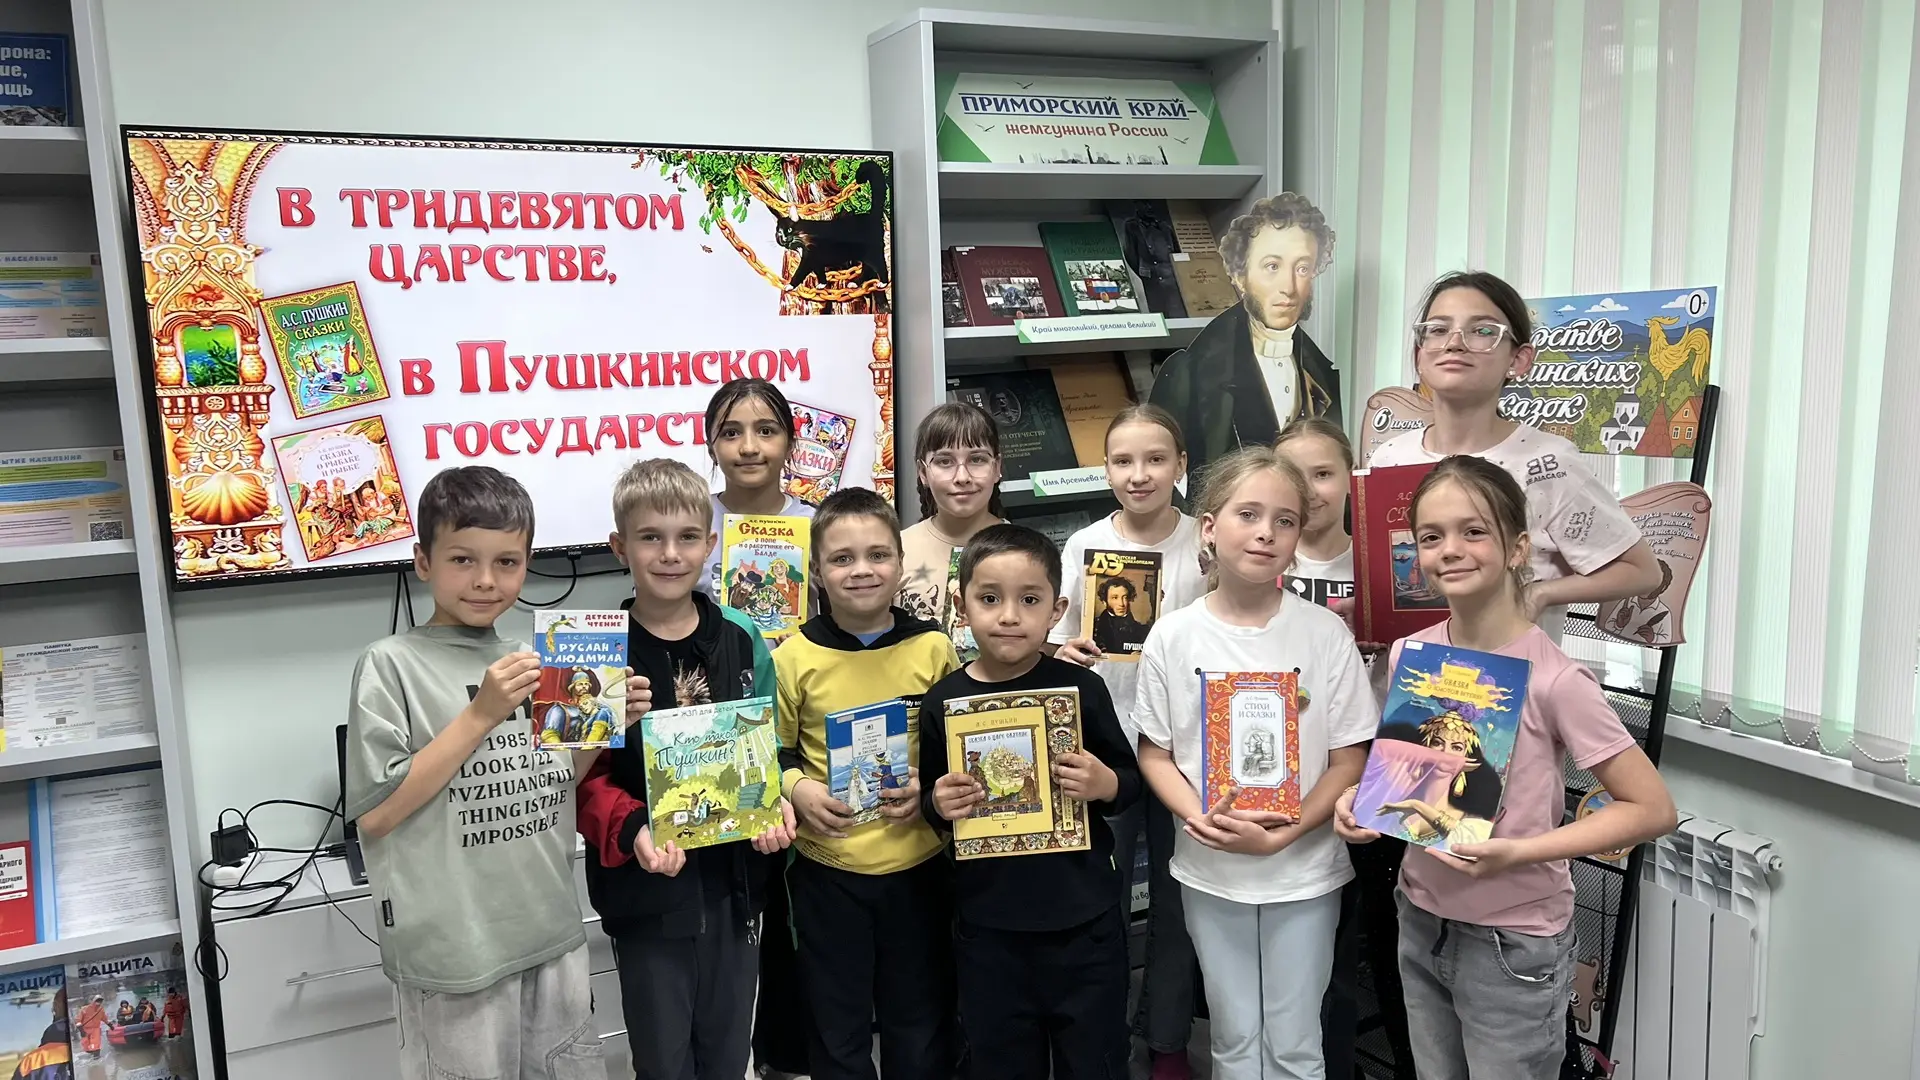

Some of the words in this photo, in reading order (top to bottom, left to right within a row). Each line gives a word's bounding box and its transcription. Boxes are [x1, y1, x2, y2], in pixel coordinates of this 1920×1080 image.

[961, 96, 1121, 116] ПРИМОРСКИЙ
[1111, 123, 1168, 137] России
[276, 187, 315, 227] В
[339, 188, 685, 234] ТРИДЕВЯТОМ
[369, 243, 617, 290] ЦАРСТВЕ,
[302, 301, 349, 324] ПУШКИН
[1689, 294, 1707, 315] 0+
[295, 320, 345, 340] СКАЗКИ
[1032, 325, 1052, 334] Край
[1531, 319, 1620, 349] рстве
[1373, 408, 1390, 428] 6
[1499, 395, 1583, 427] казок
[424, 412, 707, 460] ГОСУДАРСТ
[320, 449, 352, 461] СКАЗКА
[1060, 474, 1099, 485] Арсеньева
[1326, 582, 1354, 597] LIF
[559, 643, 609, 652] РУСЛАН
[555, 653, 622, 663] ЛЮДМИЛА
[1246, 711, 1276, 719] СКАЗКИ
[485, 732, 528, 751] 1985
[673, 732, 700, 746] Кто
[460, 756, 516, 779] LOOK
[655, 740, 736, 780] Пушкин?
[458, 803, 521, 826] THING
[78, 956, 154, 979] ЗАЩИТА
